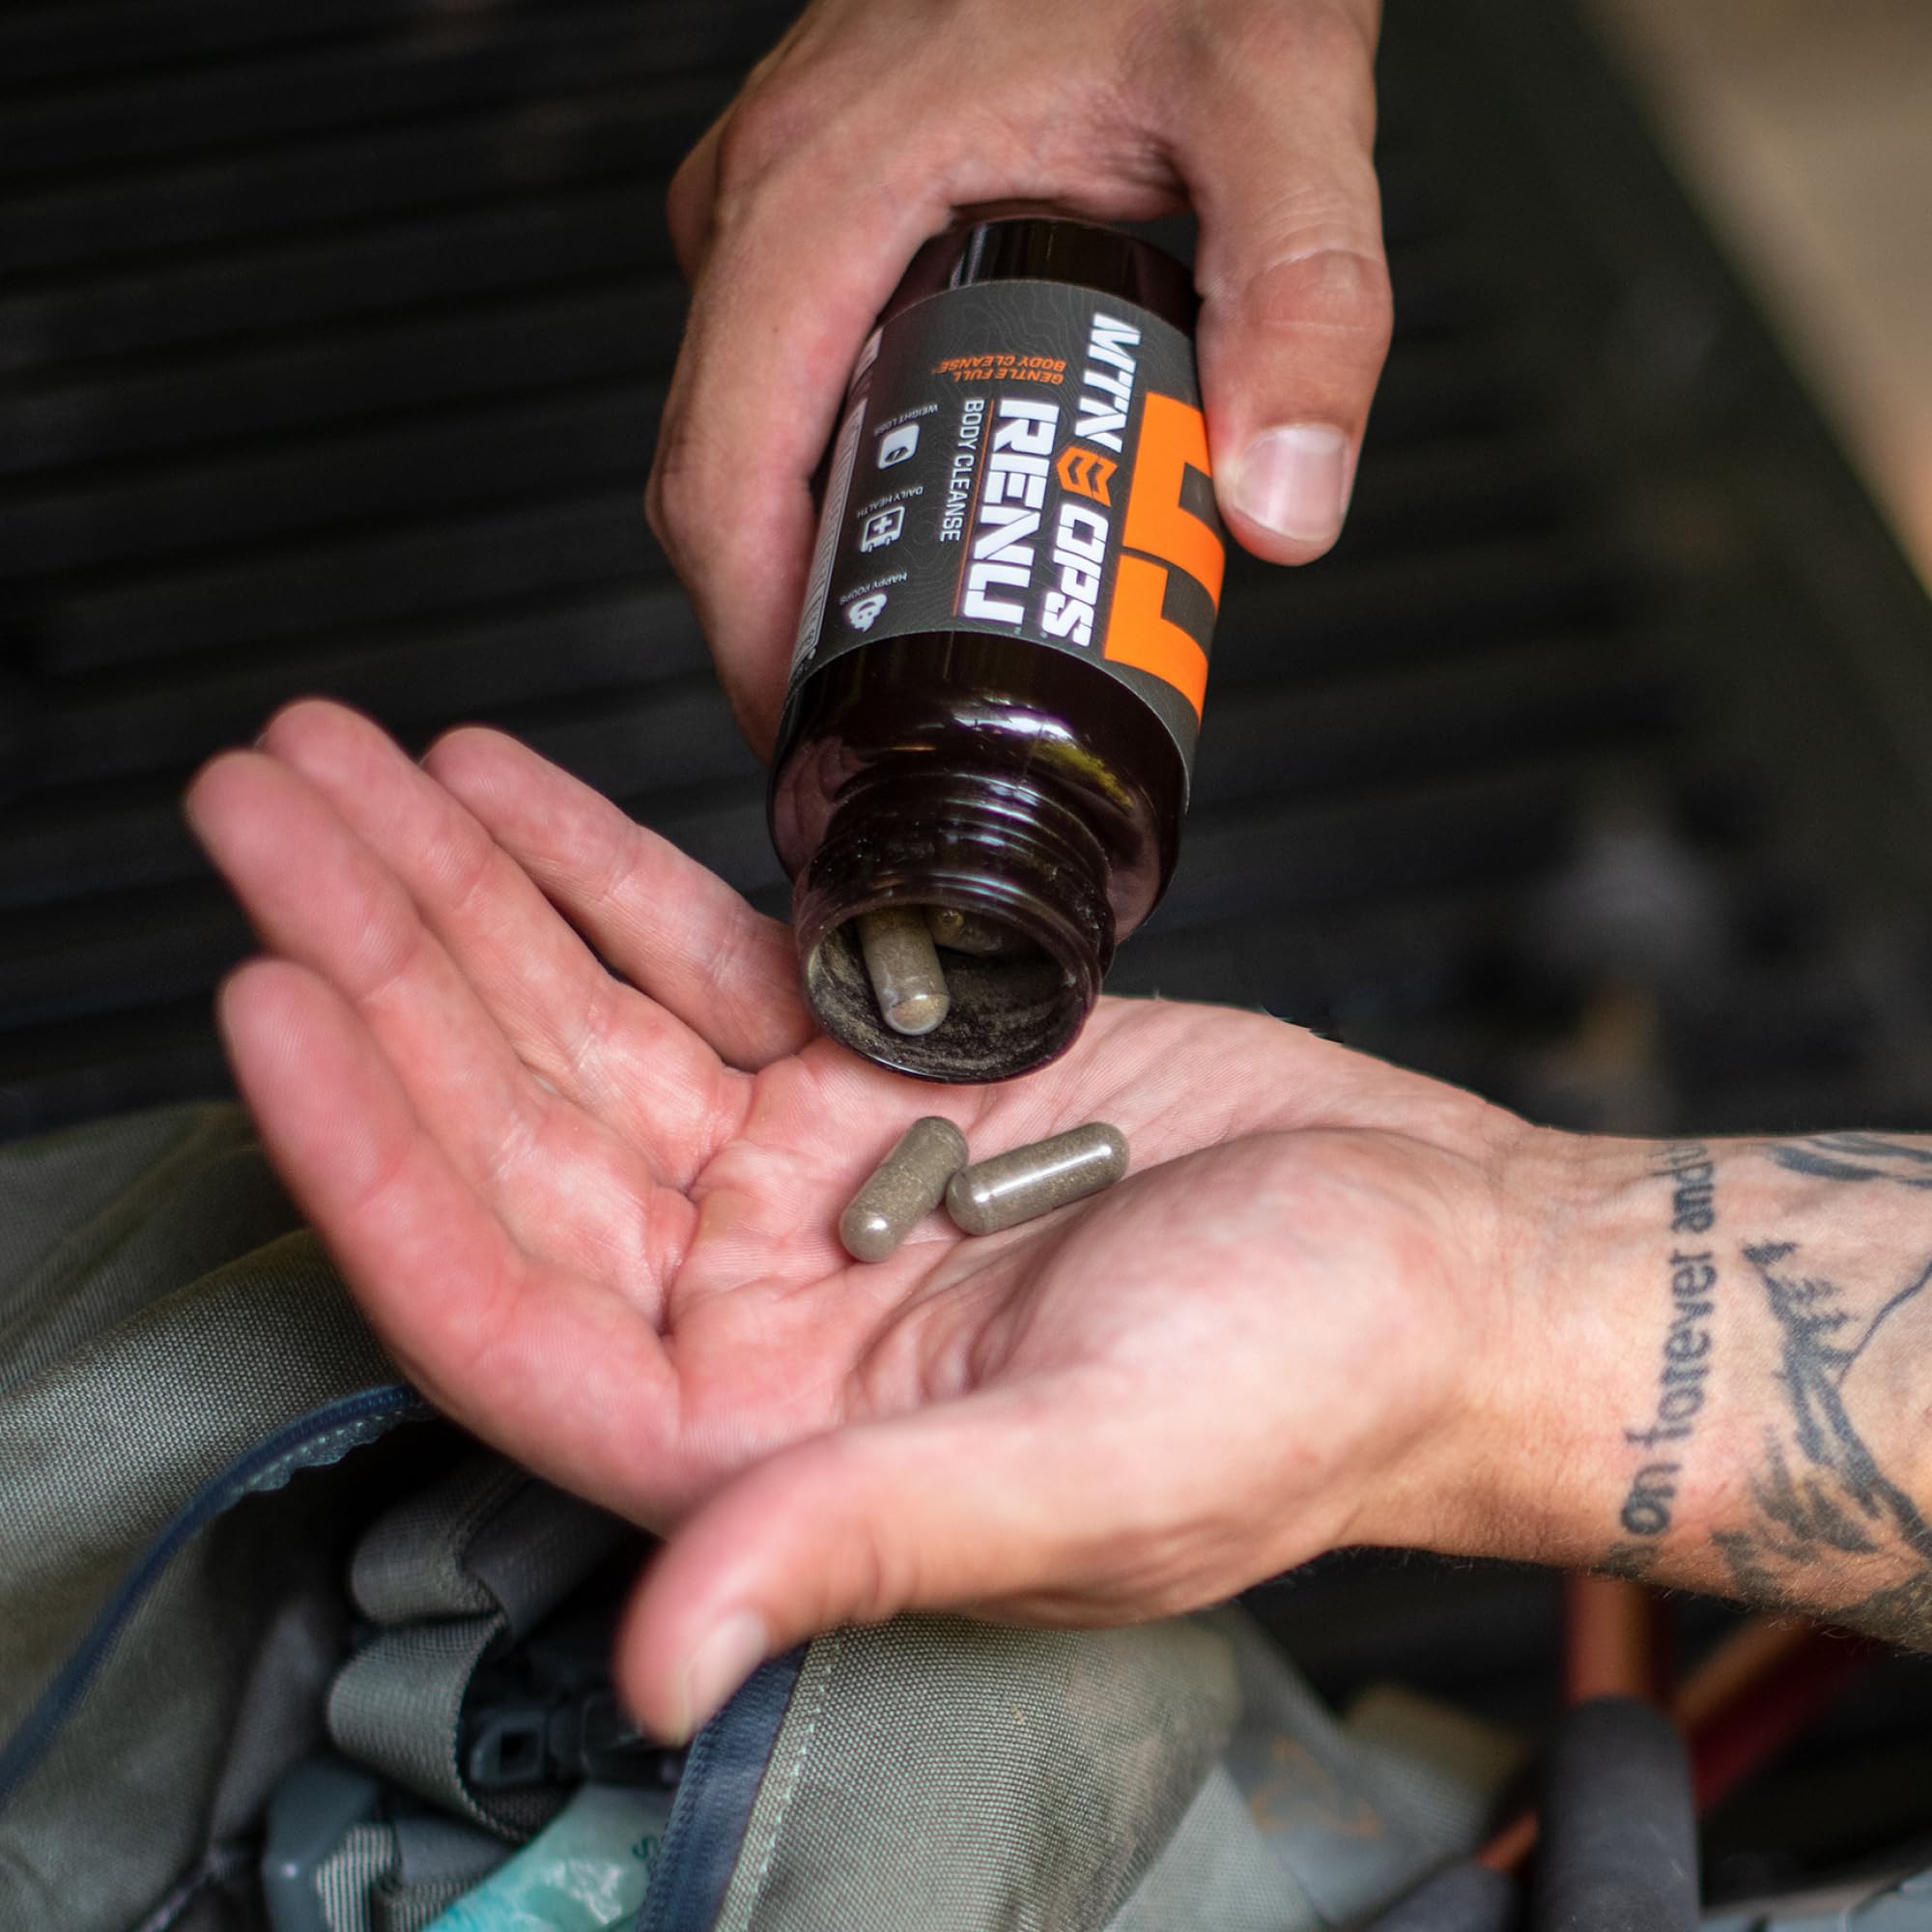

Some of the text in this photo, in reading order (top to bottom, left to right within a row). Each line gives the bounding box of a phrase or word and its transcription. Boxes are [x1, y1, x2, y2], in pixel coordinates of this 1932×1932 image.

[954, 367, 1064, 384] GENTLE FULL
[1016, 357, 1066, 372] BODY
[896, 404, 939, 425] WEIGHT
[895, 486, 923, 503] DAILY
[940, 398, 985, 542] BODY CLEANSE
[1041, 312, 1142, 647] MTN OPS
[963, 397, 1060, 625] RENU
[868, 573, 908, 592] HAPPY
[1652, 1161, 1716, 1235] and
[1625, 1248, 1719, 1447] forever
[1620, 1461, 1683, 1535] on
